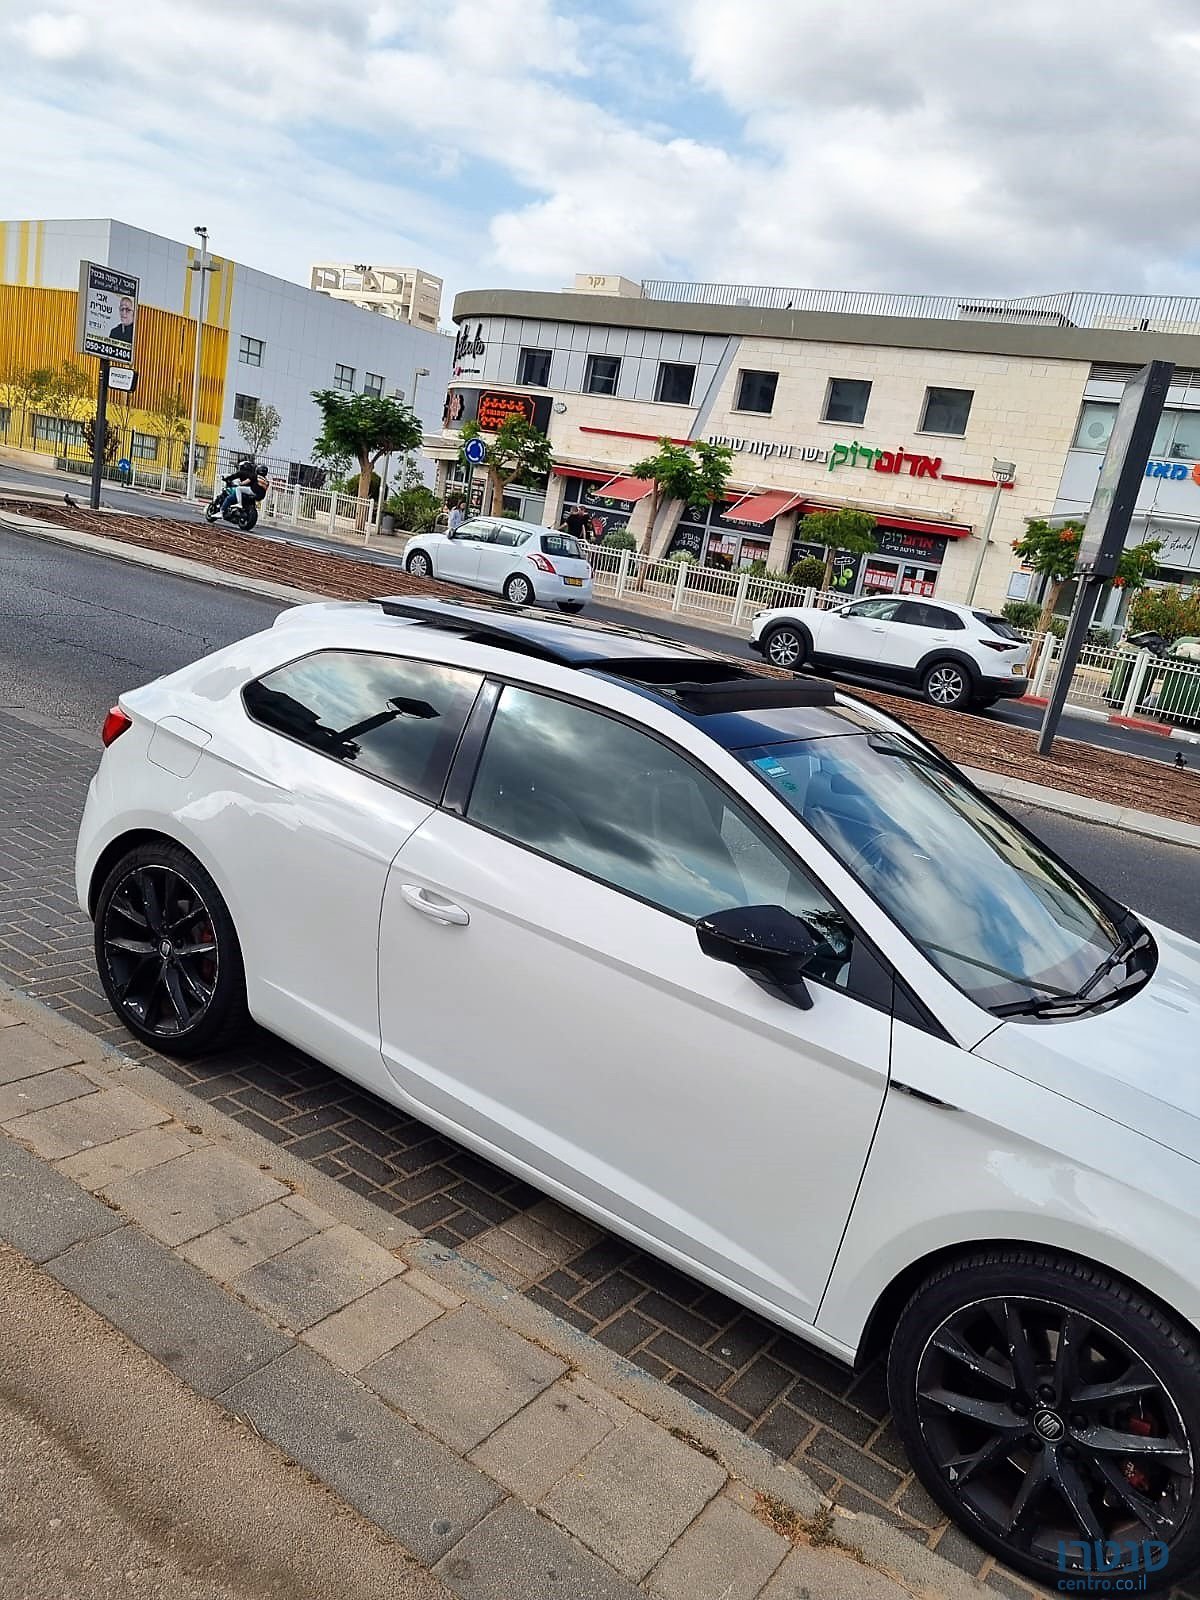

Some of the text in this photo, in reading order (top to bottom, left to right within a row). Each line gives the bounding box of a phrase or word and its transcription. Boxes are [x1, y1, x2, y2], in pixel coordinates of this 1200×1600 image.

[97, 292, 108, 303] אבי
[90, 300, 113, 314] שטרית
[86, 340, 131, 360] 050-240-1404
[748, 439, 793, 461] וירקות
[799, 446, 829, 464] בשר
